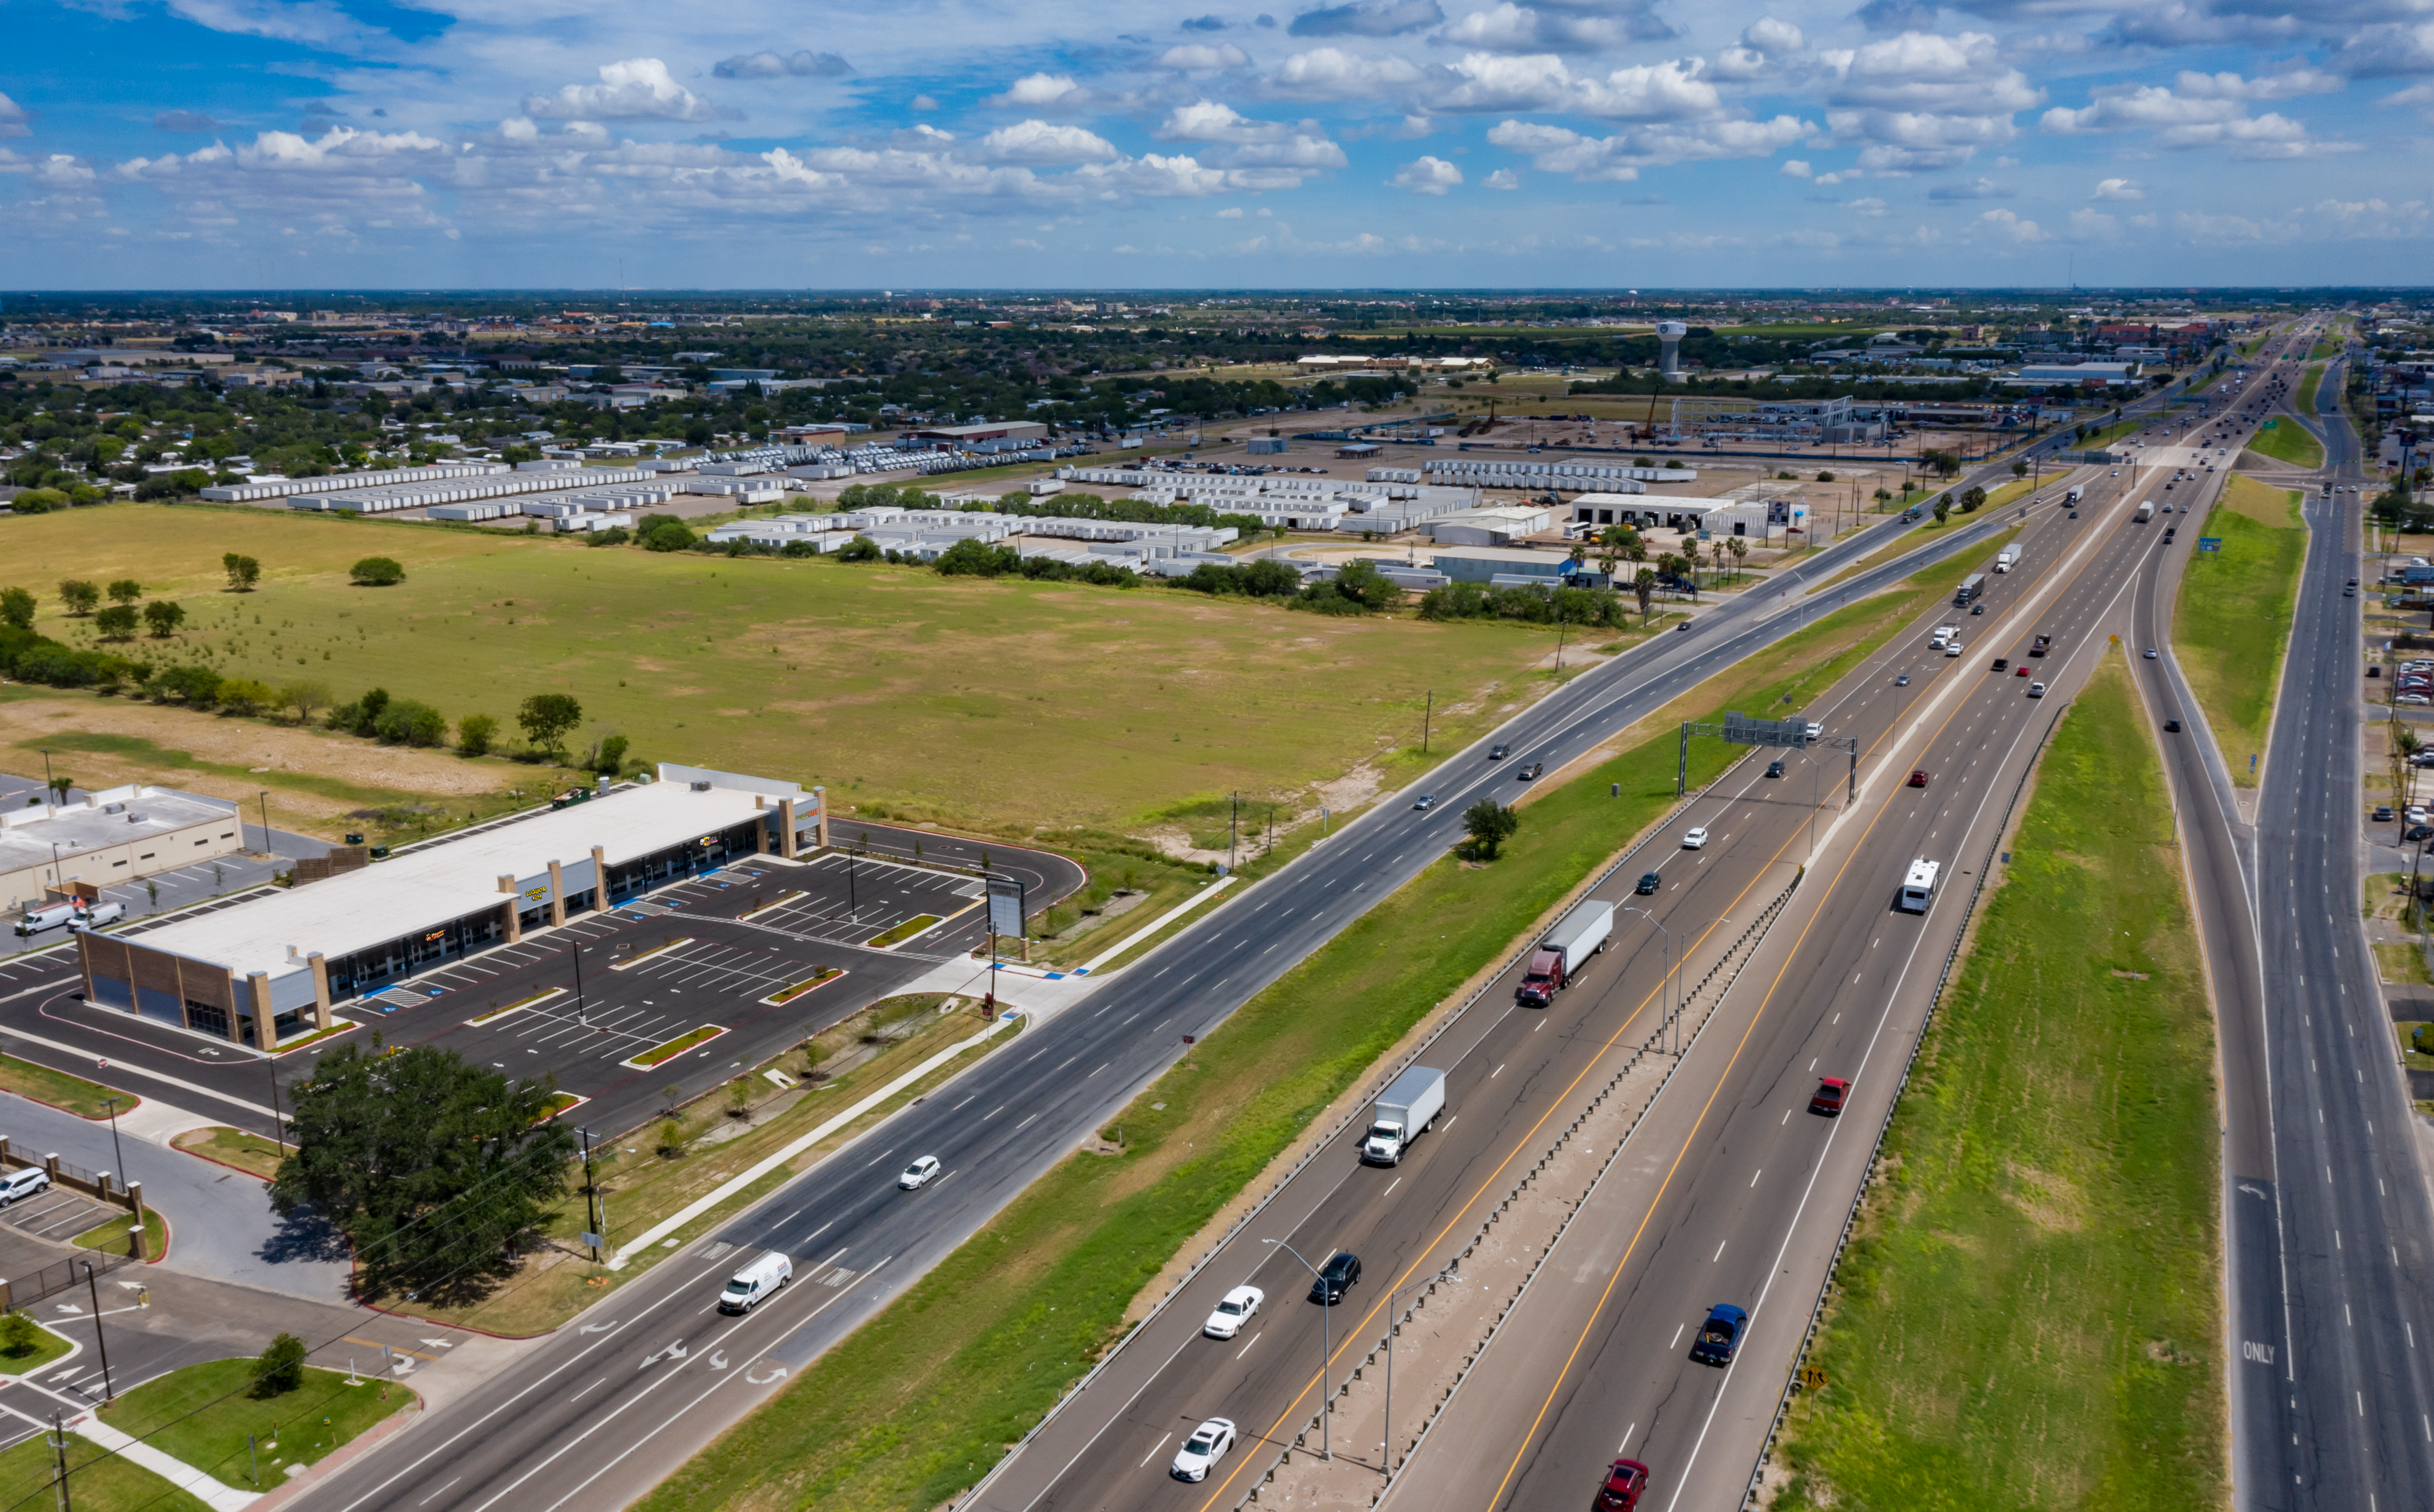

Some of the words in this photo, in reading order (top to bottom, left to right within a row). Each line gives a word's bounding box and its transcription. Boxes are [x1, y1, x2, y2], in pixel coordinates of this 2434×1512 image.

[808, 808, 818, 817] CAFE
[532, 893, 543, 901] 101
[692, 1241, 733, 1260] ONLY
[815, 1267, 856, 1287] ONLY
[2244, 1340, 2275, 1365] ONLY
